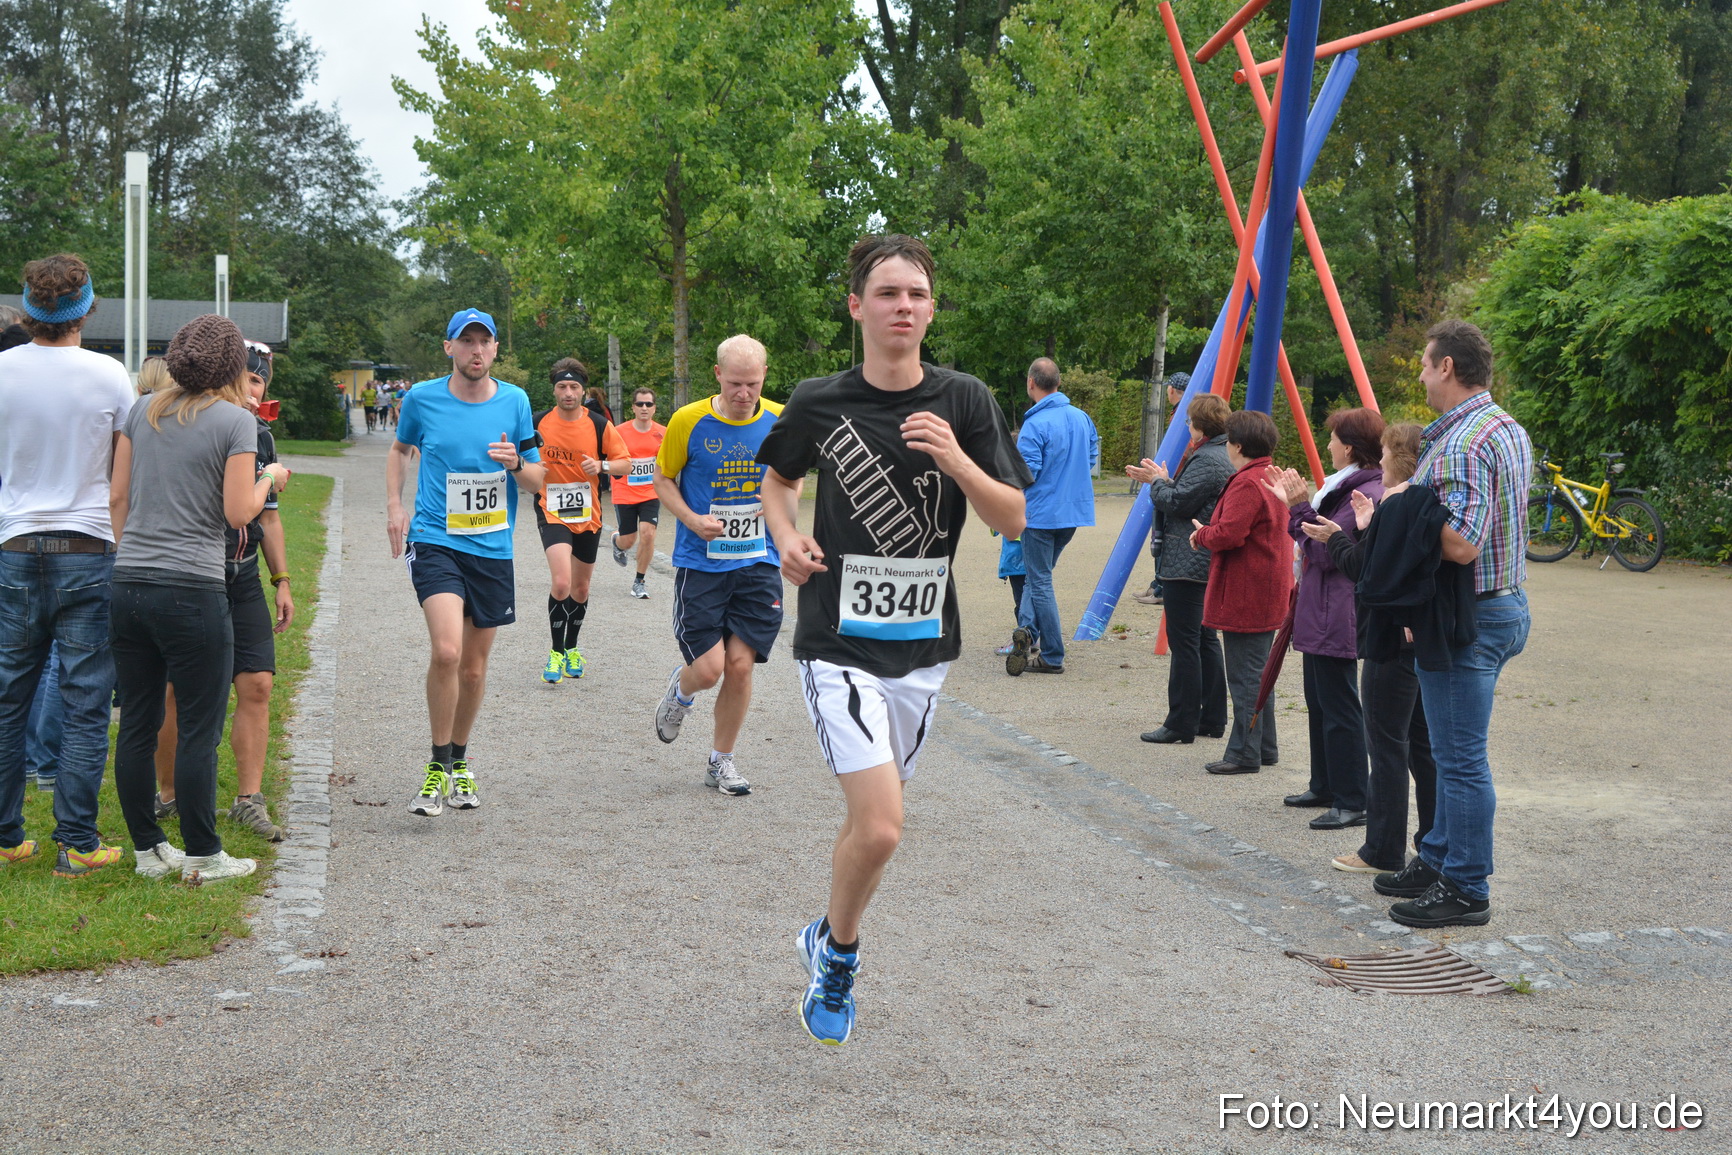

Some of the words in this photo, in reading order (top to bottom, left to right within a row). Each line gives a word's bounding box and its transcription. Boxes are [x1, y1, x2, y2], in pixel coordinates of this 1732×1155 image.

[630, 463, 655, 475] 2600
[473, 477, 499, 485] Neumarkt
[462, 487, 497, 510] 156
[557, 492, 584, 508] 129
[470, 515, 490, 525] Wolfi
[720, 542, 756, 552] Christoph
[845, 564, 881, 576] PARTL
[885, 567, 934, 577] Neumarkt
[852, 580, 938, 617] 3340
